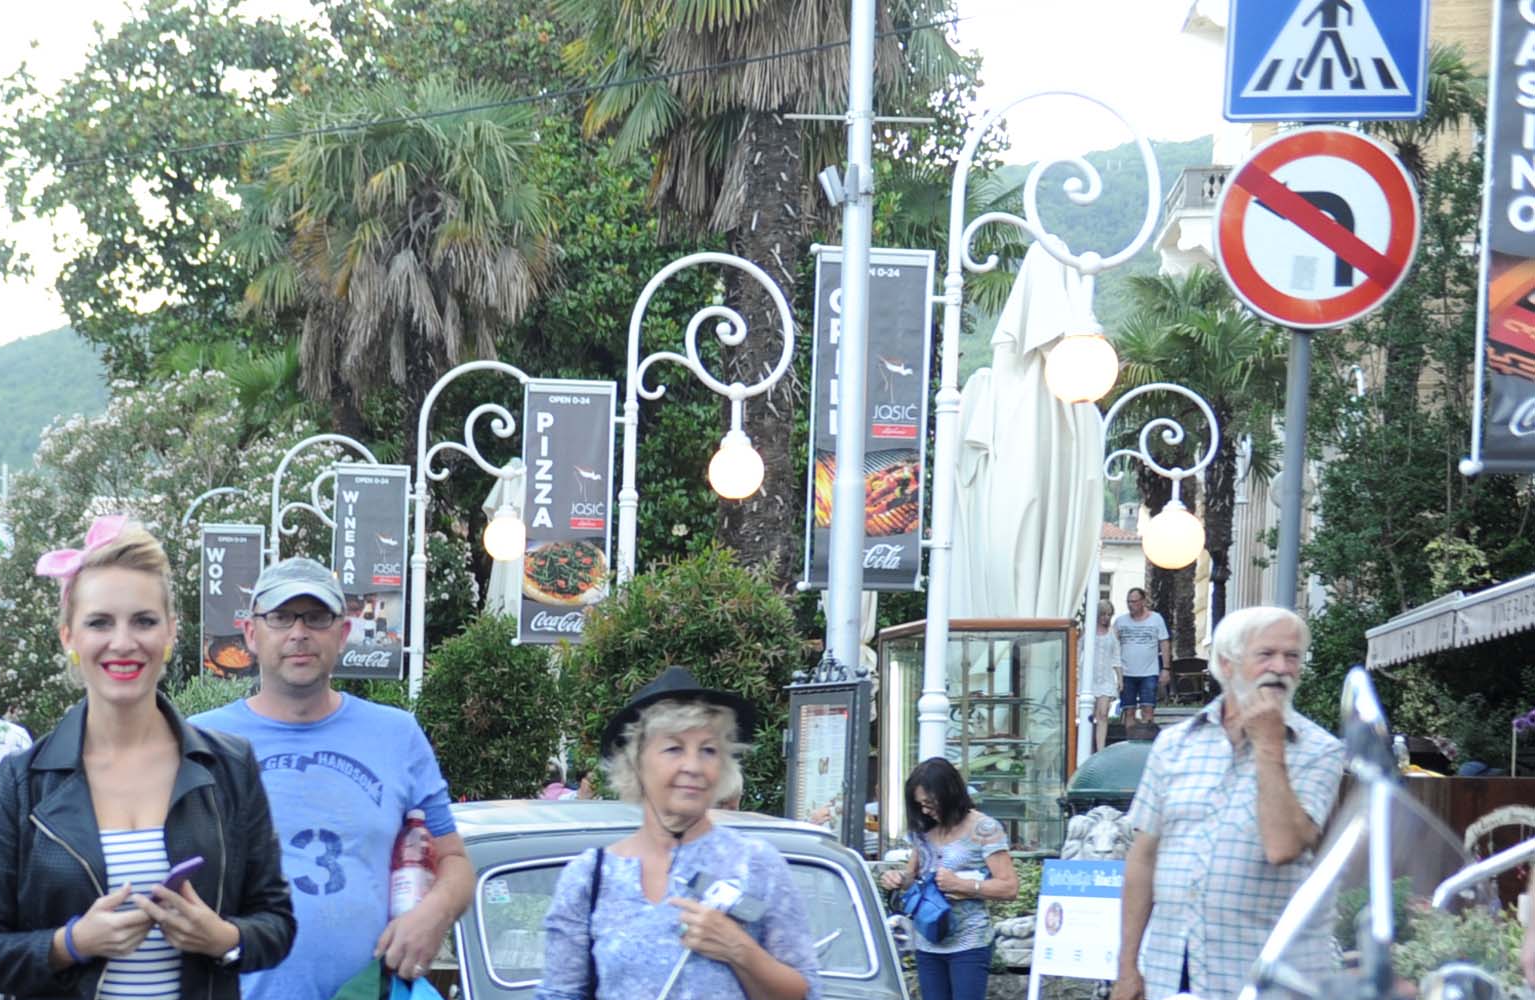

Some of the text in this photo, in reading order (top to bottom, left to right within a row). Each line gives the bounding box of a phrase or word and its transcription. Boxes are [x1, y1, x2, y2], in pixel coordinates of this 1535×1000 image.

[532, 411, 554, 528] PIZZA
[206, 547, 225, 595] WOK
[264, 755, 298, 769] GET
[290, 828, 346, 896] 3
